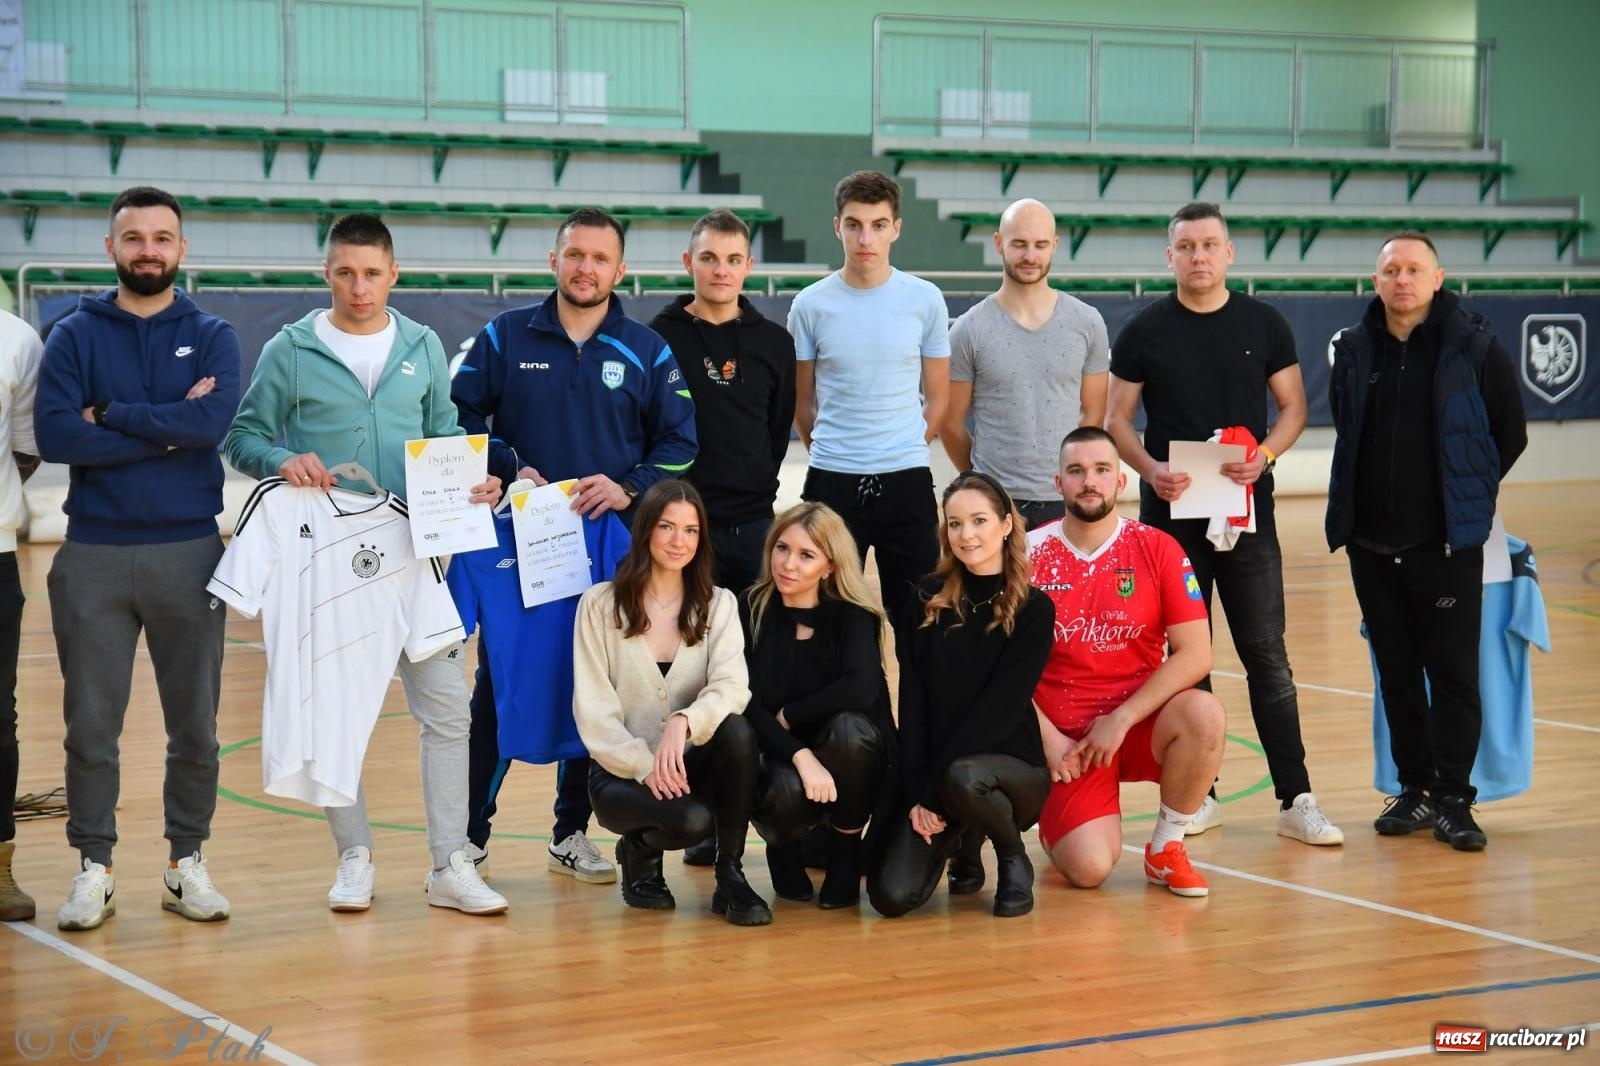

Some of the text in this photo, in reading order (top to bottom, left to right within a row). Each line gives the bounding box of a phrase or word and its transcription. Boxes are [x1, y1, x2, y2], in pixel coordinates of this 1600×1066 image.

[428, 454, 465, 467] Dyplom
[441, 467, 454, 477] dla
[531, 502, 561, 517] Dyplom
[1101, 610, 1128, 621] Willa
[1054, 616, 1146, 643] Wiktoria
